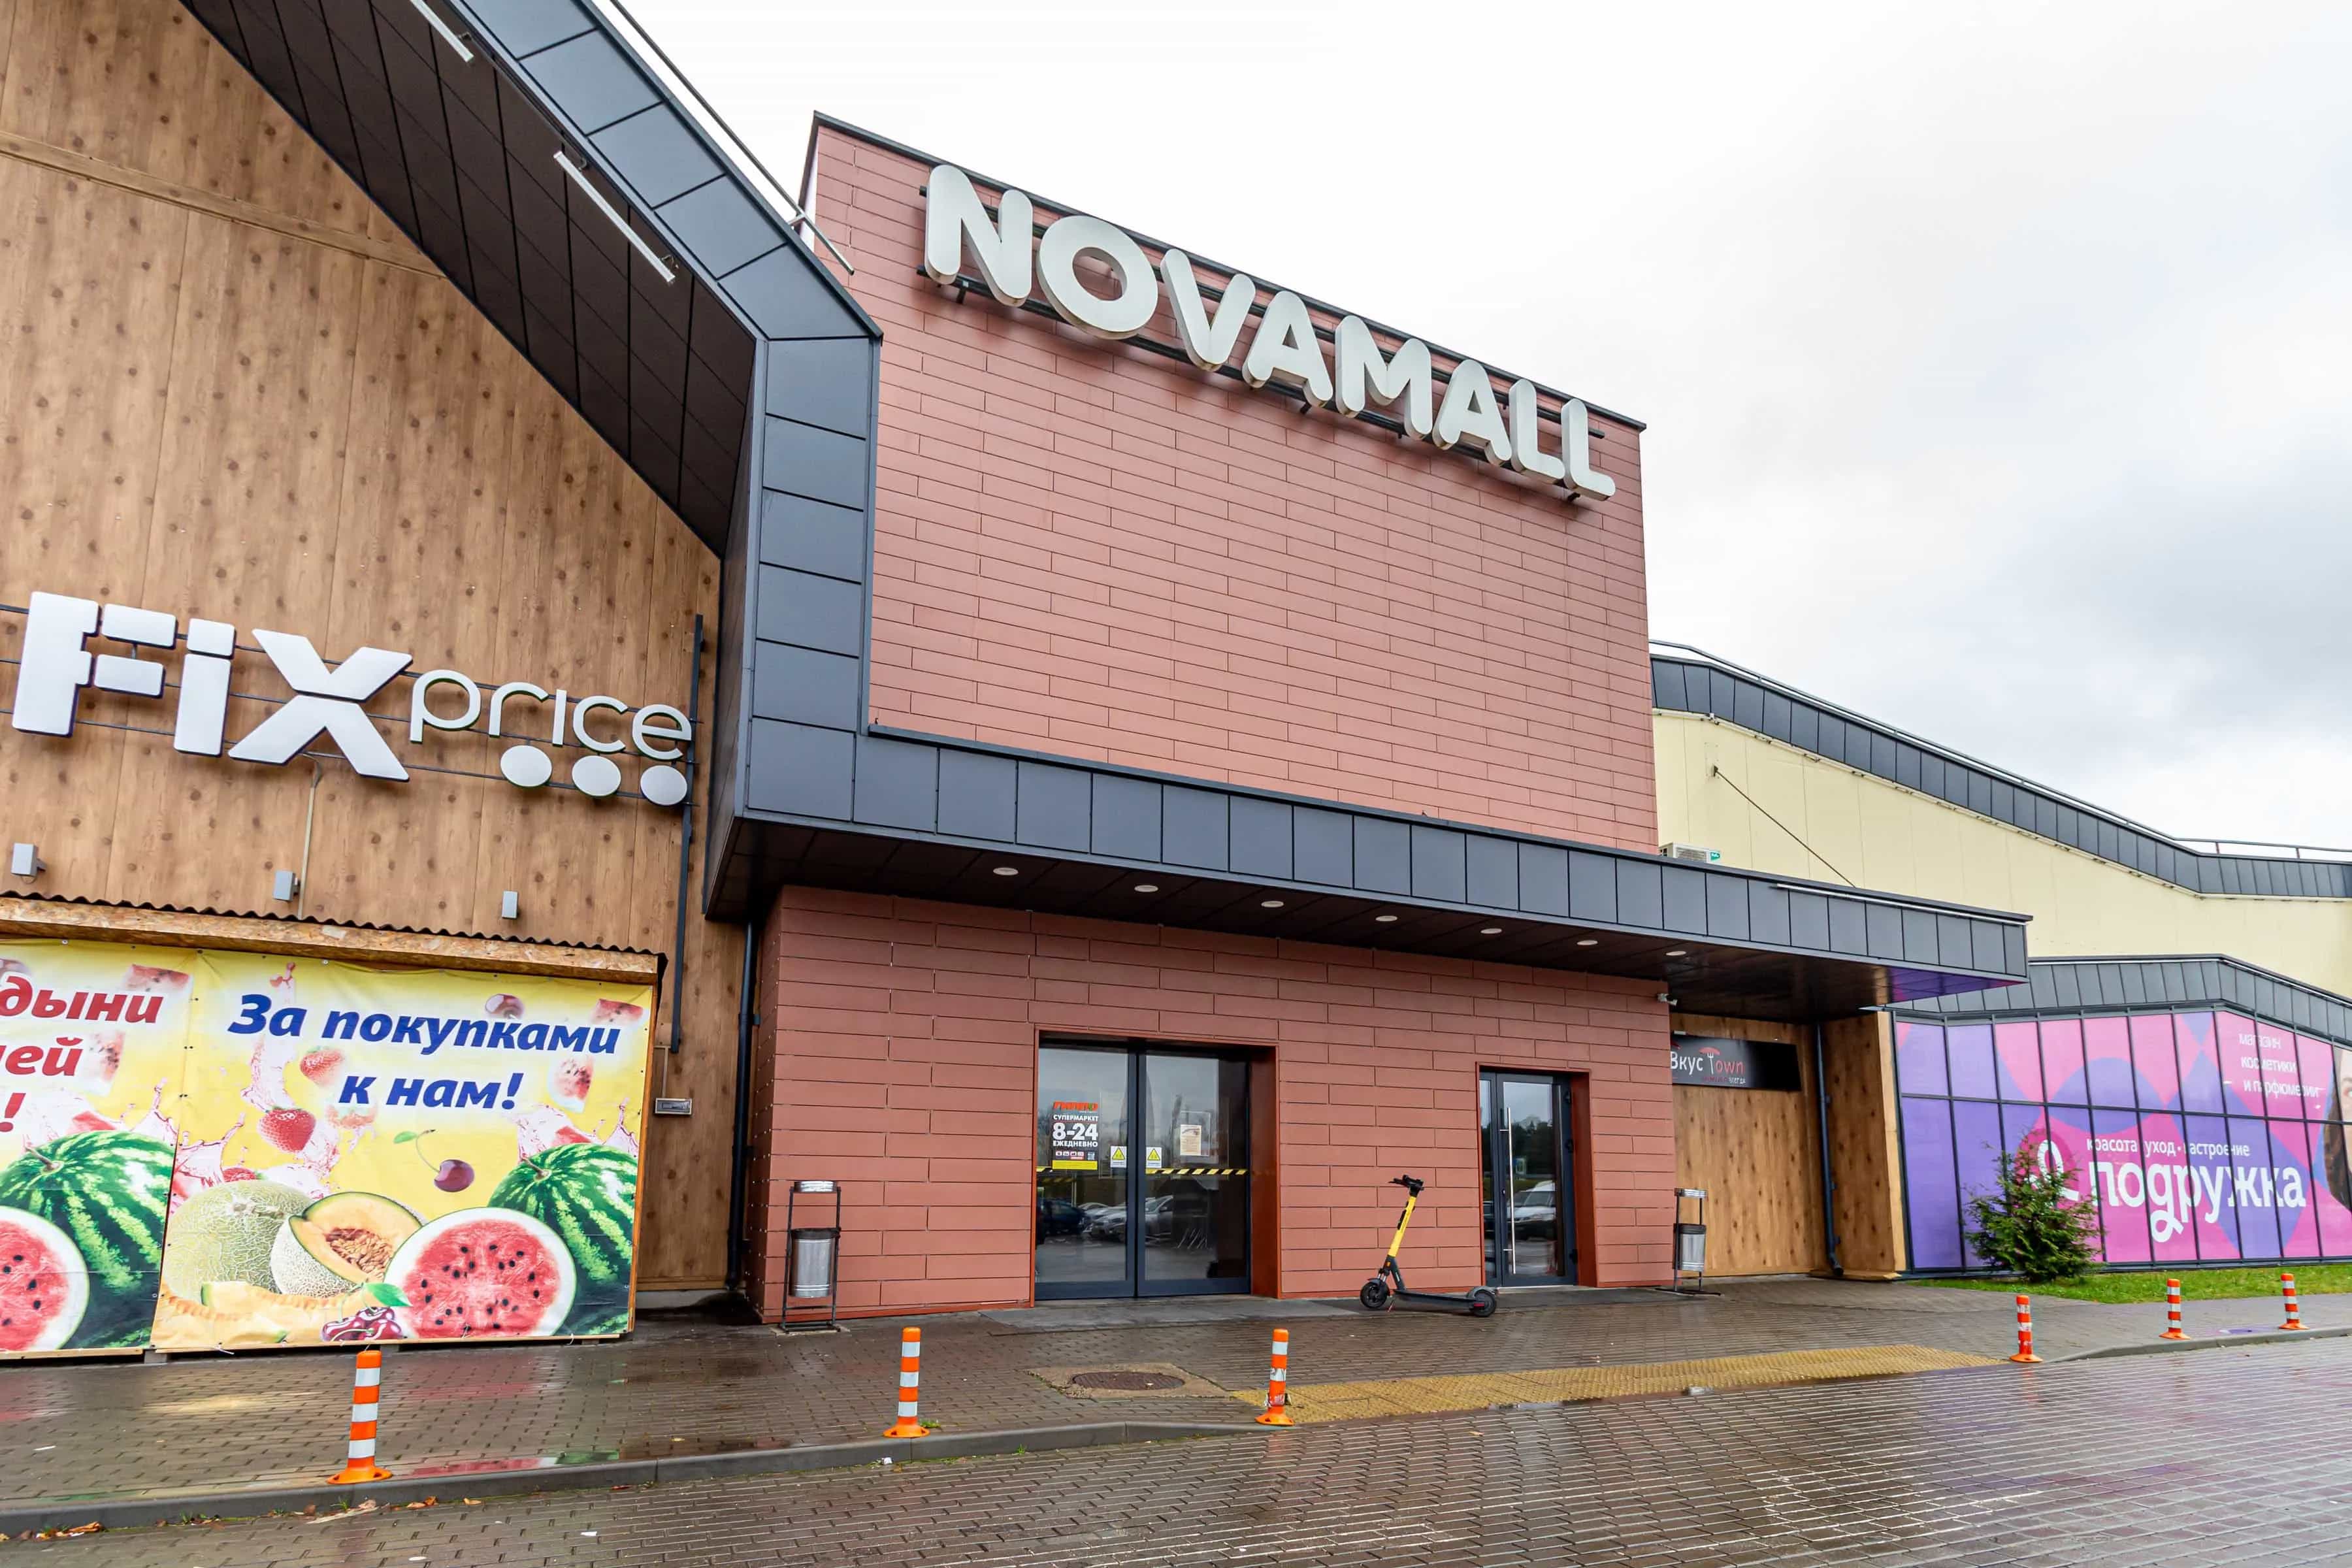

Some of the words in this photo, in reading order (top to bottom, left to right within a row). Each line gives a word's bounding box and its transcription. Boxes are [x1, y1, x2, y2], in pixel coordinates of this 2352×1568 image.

[924, 165, 1616, 501] NOVAMALL
[410, 669, 691, 761] price
[0, 976, 163, 1023] дыни
[227, 994, 307, 1037] За
[321, 1009, 621, 1055] покупками
[0, 1037, 84, 1076] ей
[1670, 1051, 1704, 1075] Вкус
[338, 1075, 376, 1104] к
[386, 1073, 524, 1109] нам!
[2253, 1078, 2319, 1098] прфюмеии
[1053, 1122, 1098, 1141] 8-24
[2144, 1141, 2176, 1158] уход
[2183, 1143, 2250, 1160] астроение
[2088, 1162, 2306, 1243] подружка
